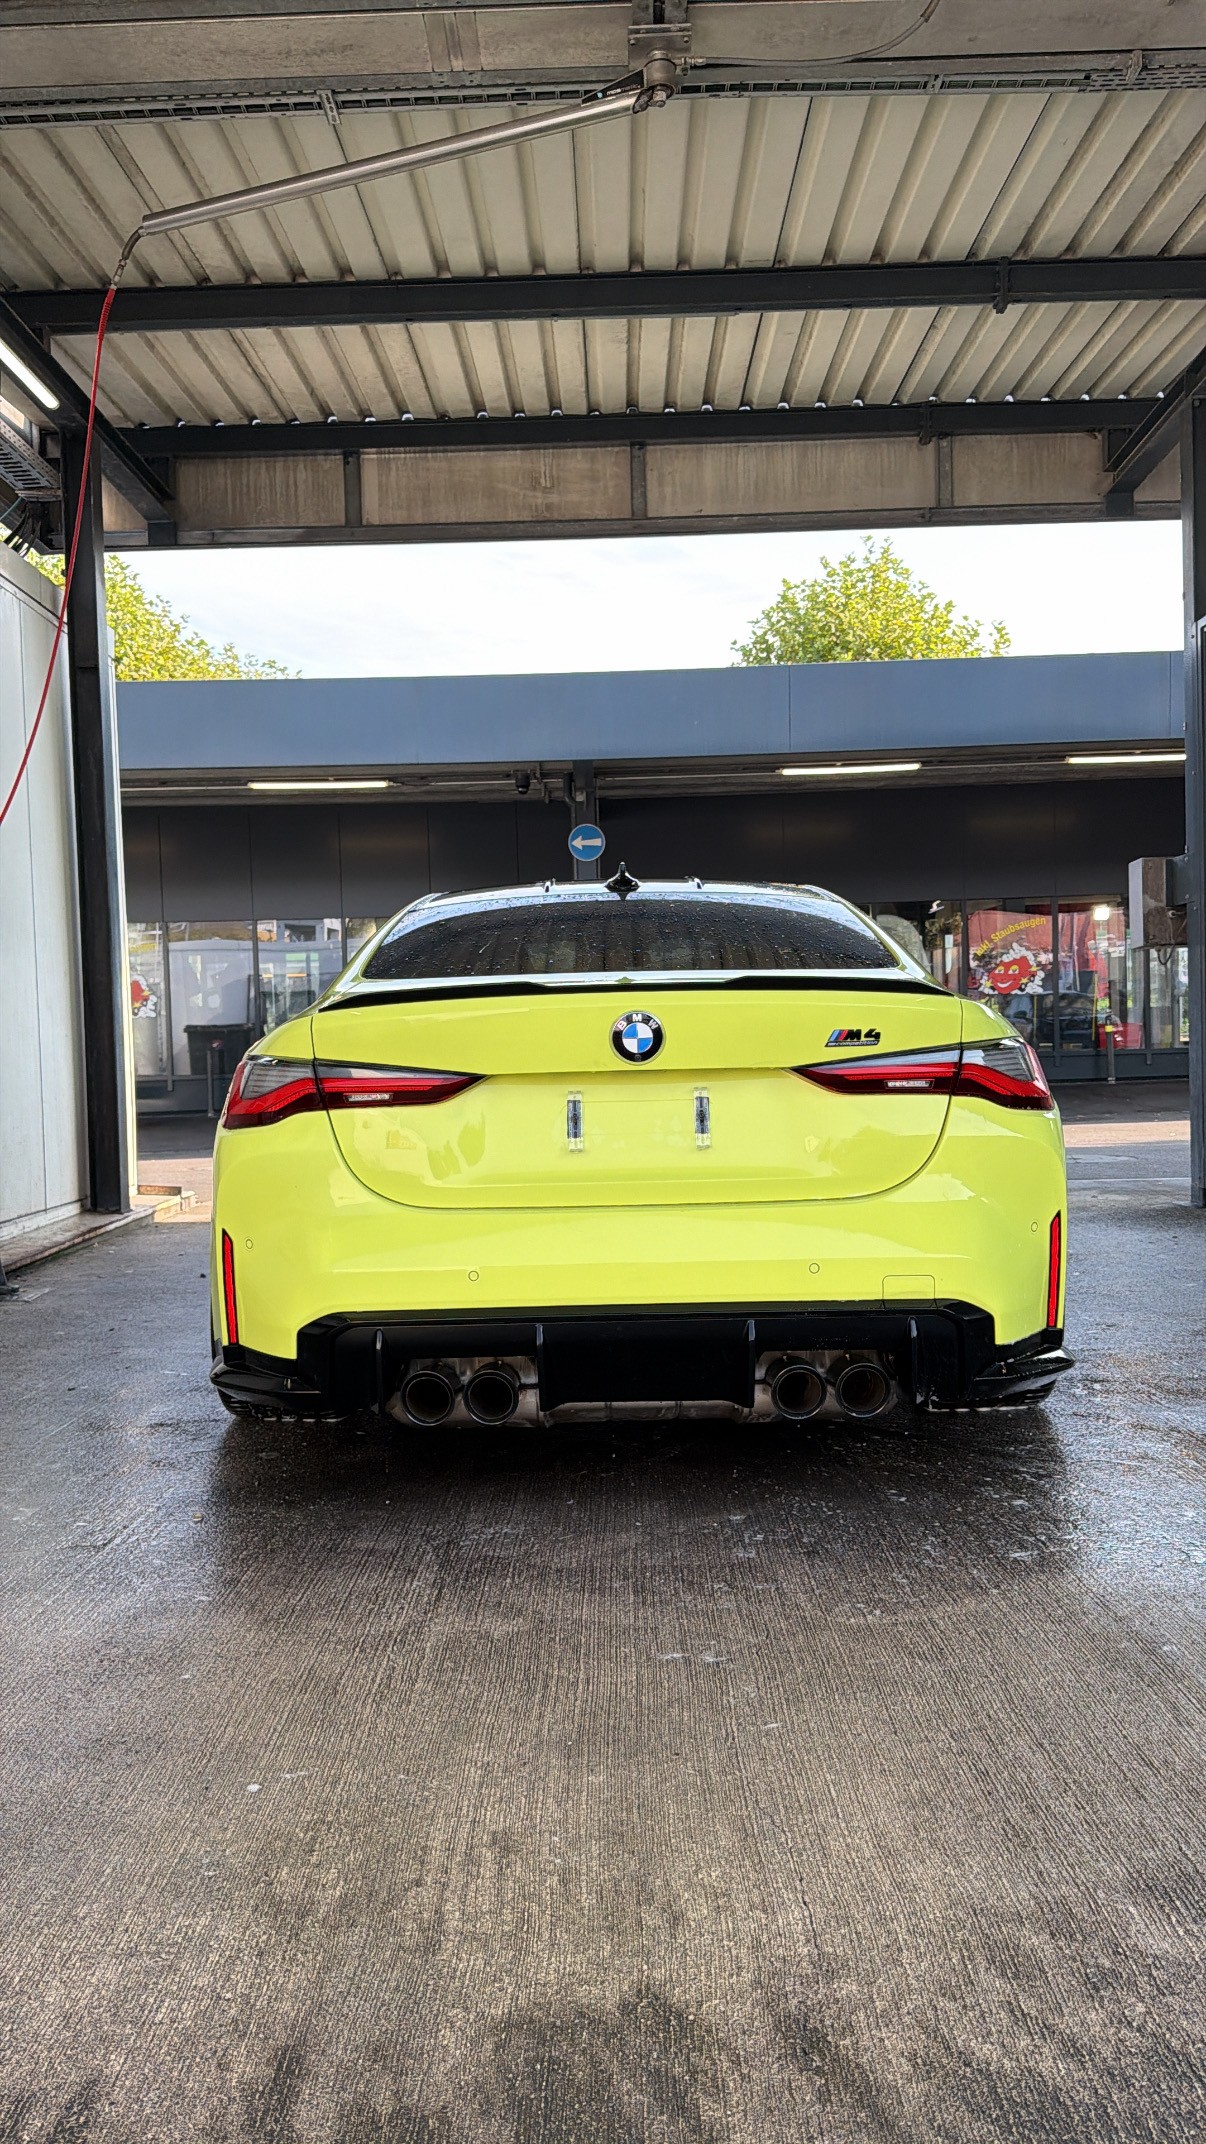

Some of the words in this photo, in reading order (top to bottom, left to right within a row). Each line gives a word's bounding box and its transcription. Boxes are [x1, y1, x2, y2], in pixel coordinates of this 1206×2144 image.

[991, 917, 1047, 942] Staubsaugen
[616, 1013, 659, 1031] BMW
[839, 1028, 882, 1041] M4
